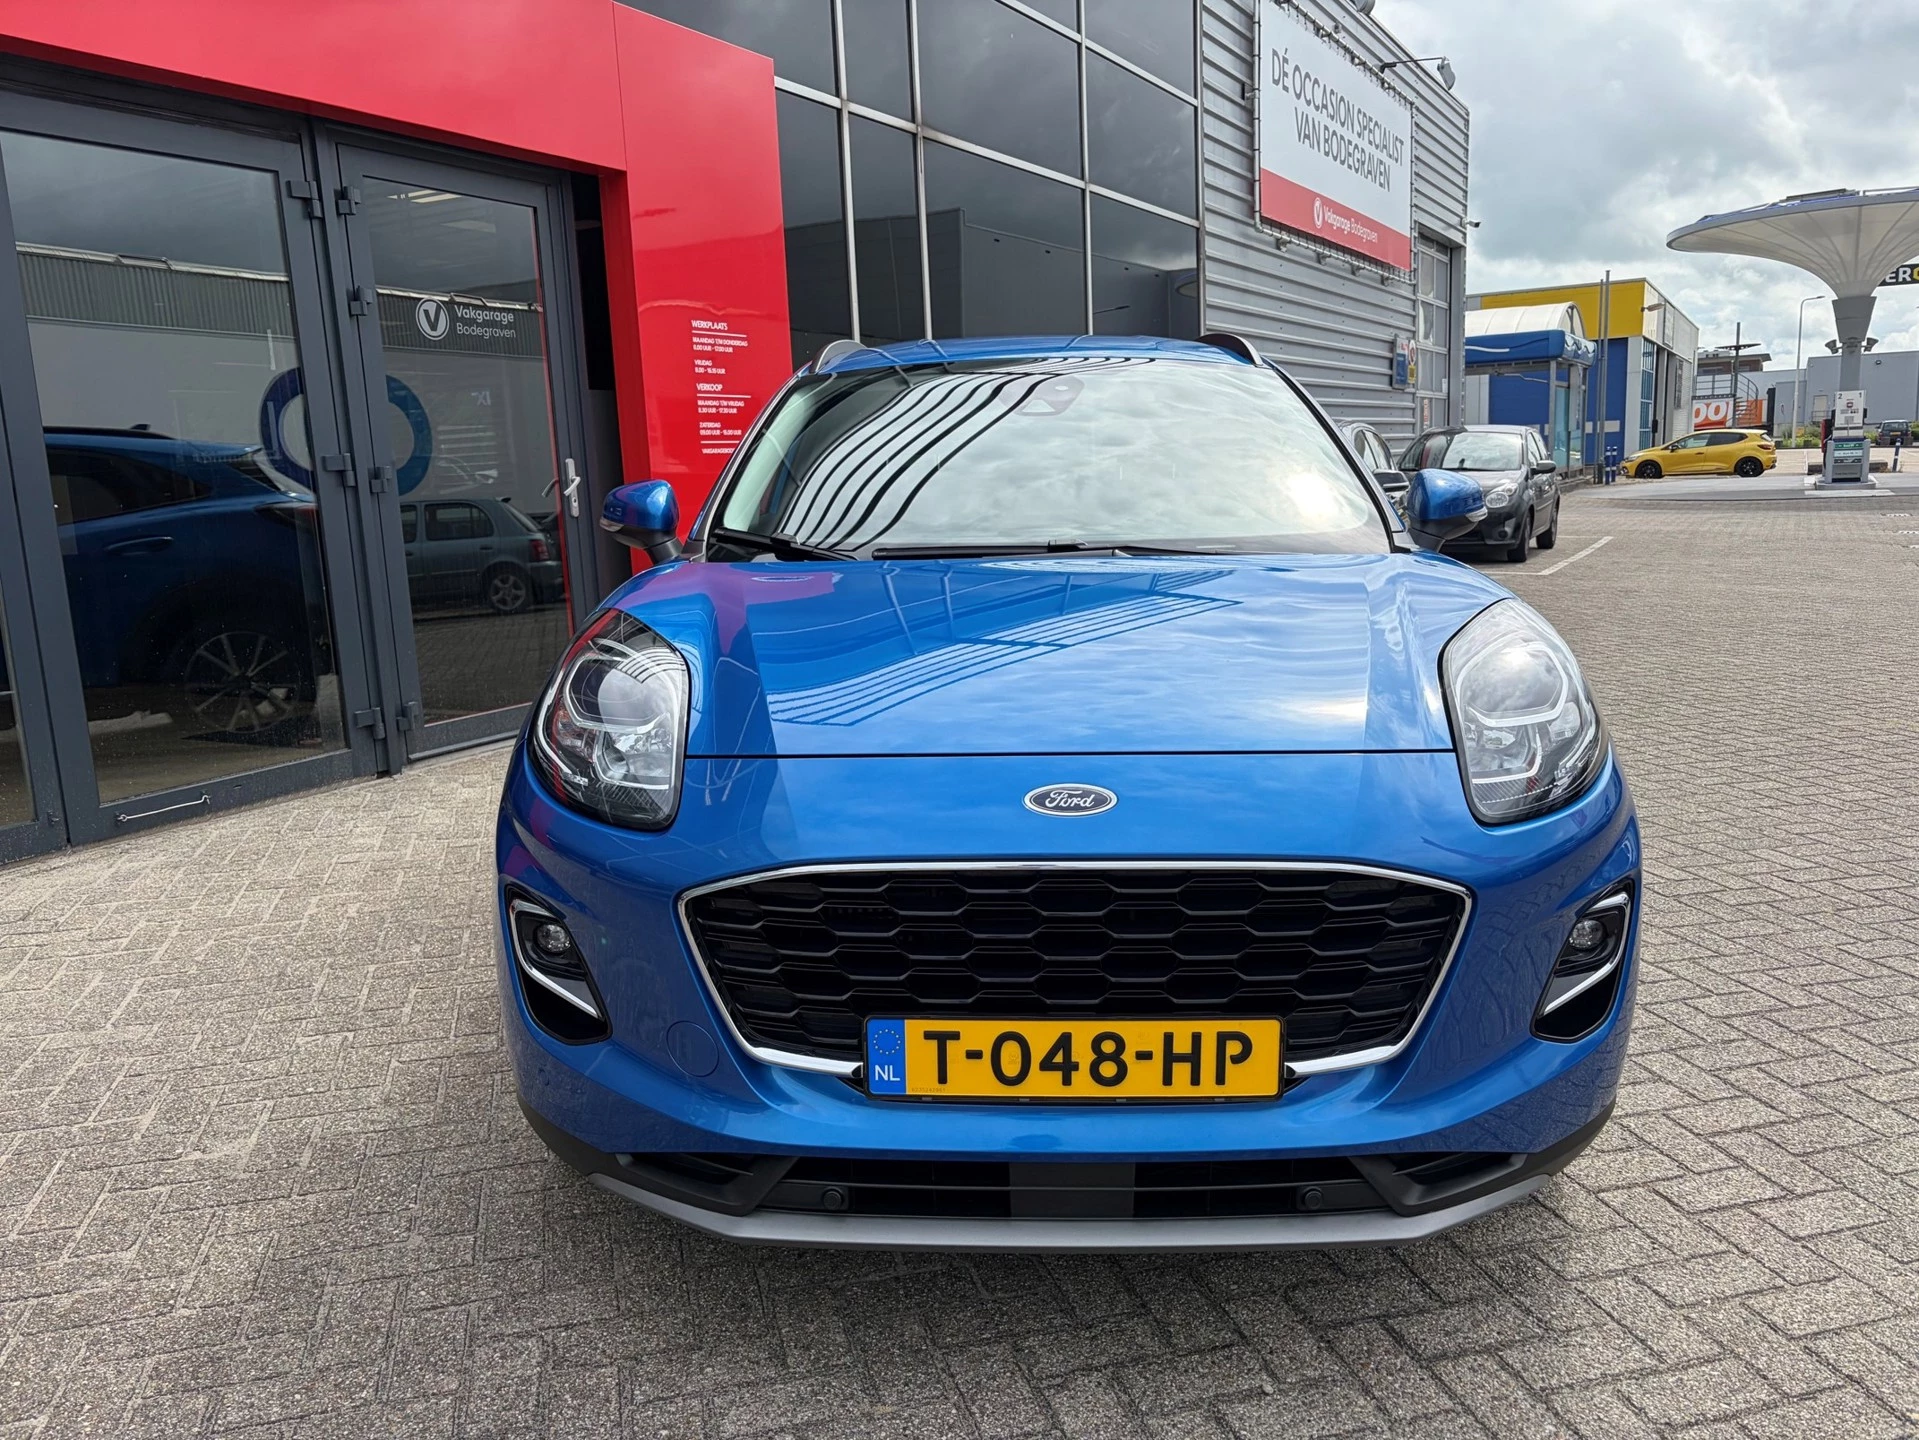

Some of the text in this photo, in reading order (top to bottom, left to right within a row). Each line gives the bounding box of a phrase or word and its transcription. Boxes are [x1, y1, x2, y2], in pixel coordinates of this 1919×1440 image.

[1271, 48, 1404, 166] DÉ OCCASION SPECIALIST
[1295, 106, 1391, 192] VAN BODEGRAVEN
[1323, 205, 1378, 243] Vakgarage Bodegraven
[454, 304, 515, 325] Vakgarage
[456, 322, 517, 340] Bodegraven
[691, 319, 728, 331] WERKPLAATS
[692, 336, 715, 344] MAANDAG
[722, 339, 748, 347] DONDERDAG
[694, 359, 712, 367] VRIJDAG
[696, 382, 723, 392] VERKOOP
[728, 400, 745, 408] VRIJDAG
[699, 421, 722, 429] ZATERDAG
[1045, 789, 1096, 808] Ford
[923, 1030, 1253, 1088] T-048-HP
[875, 1064, 901, 1081] NL
